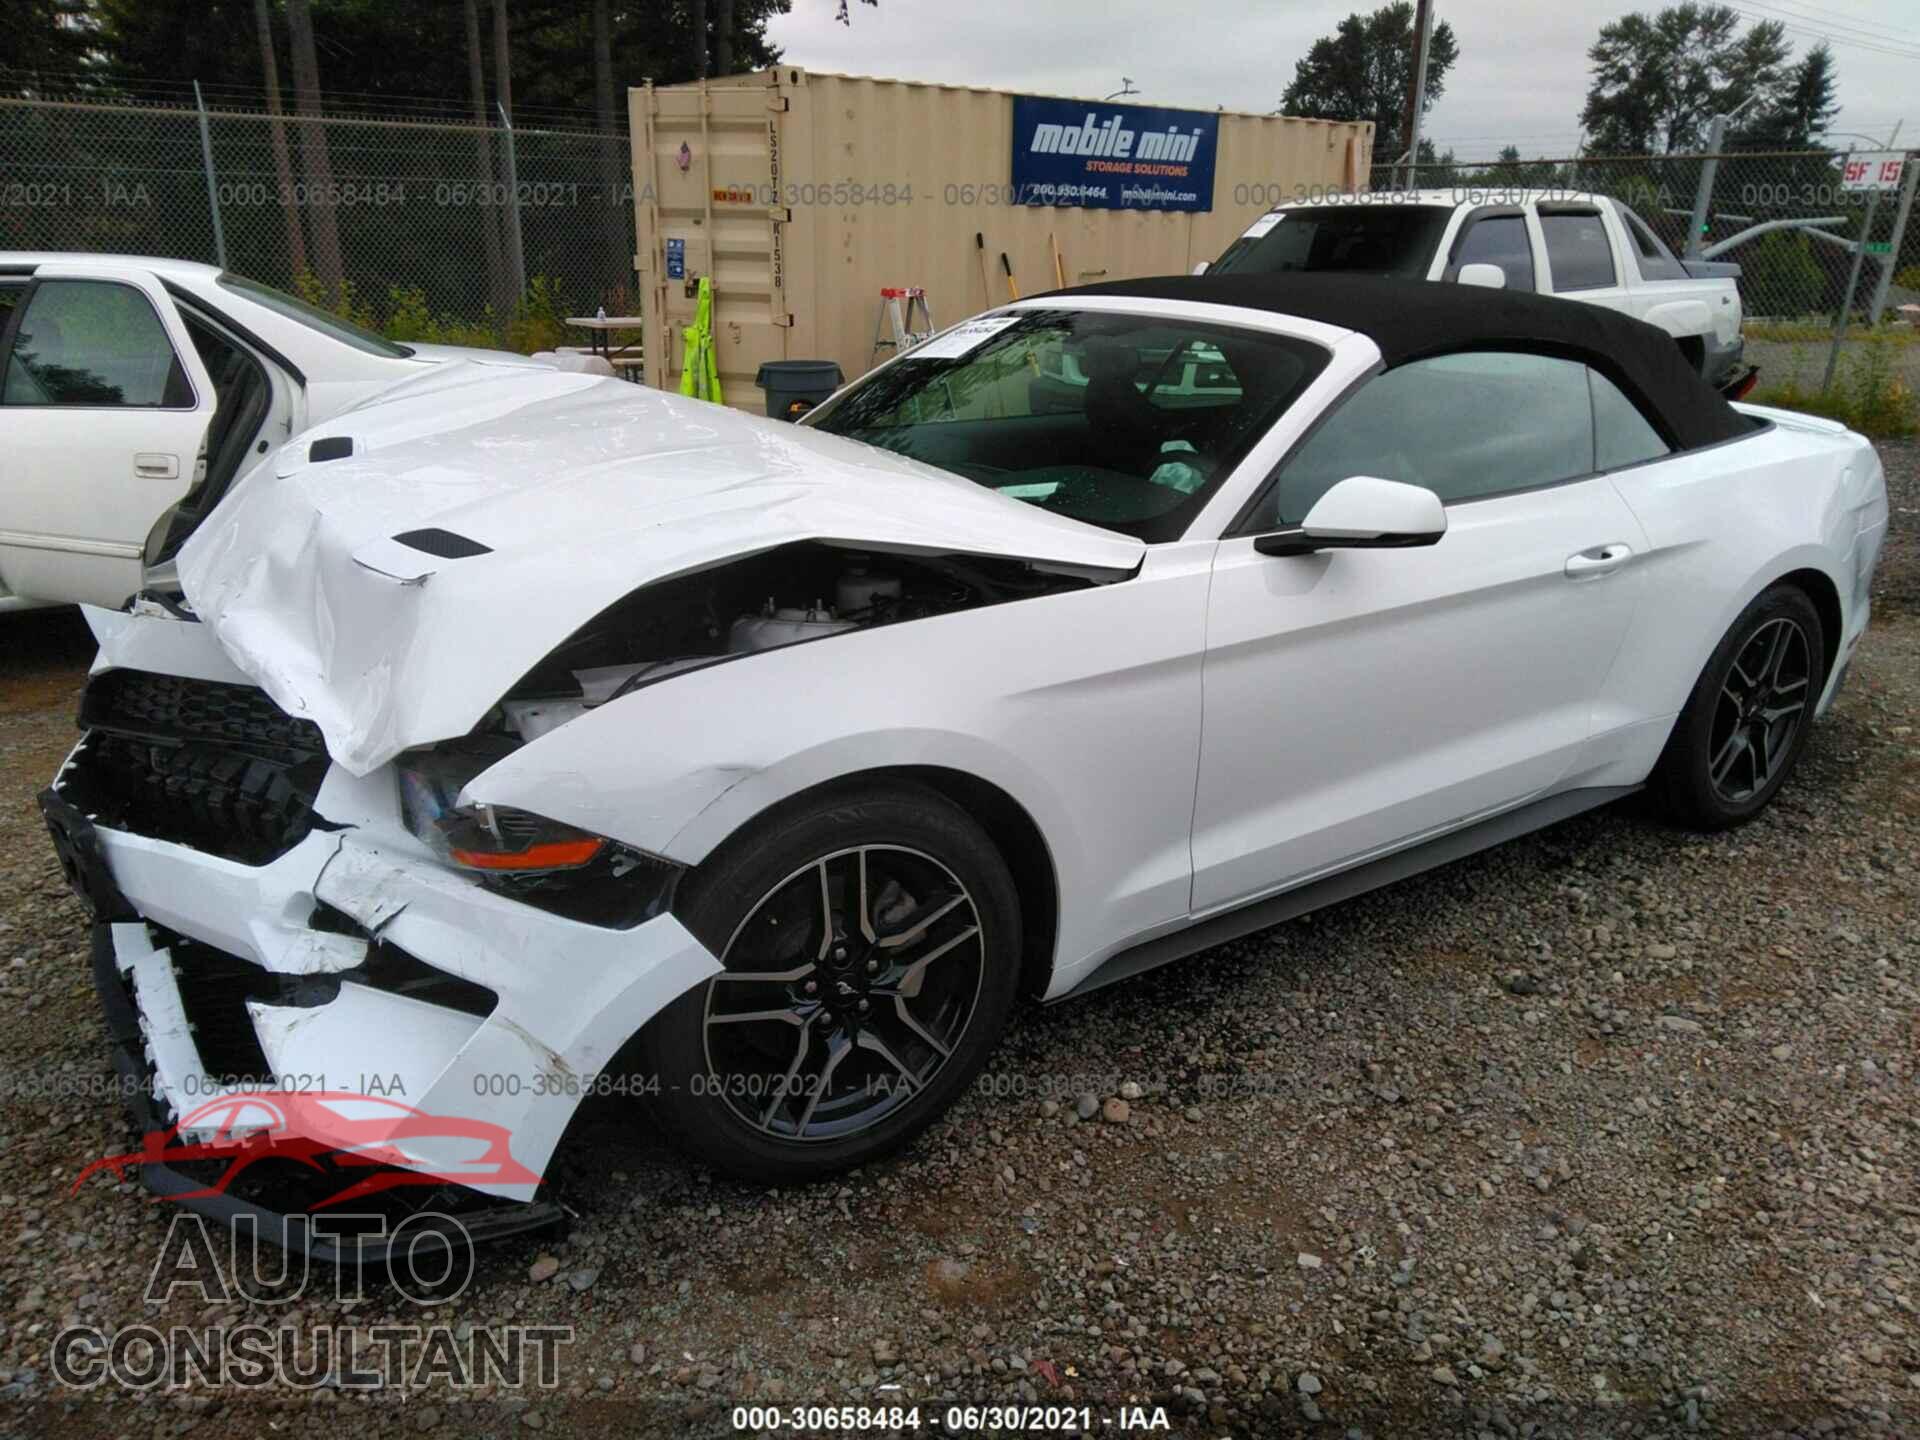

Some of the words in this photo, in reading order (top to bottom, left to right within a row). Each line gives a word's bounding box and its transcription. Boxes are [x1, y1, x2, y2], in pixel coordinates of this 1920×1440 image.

[1030, 113, 1135, 158] mobile
[1136, 126, 1202, 162] mini
[1086, 160, 1133, 174] STORAGE
[1134, 163, 1188, 177] SOLUTIONS
[1845, 161, 1872, 181] SF
[1878, 161, 1901, 182] 15
